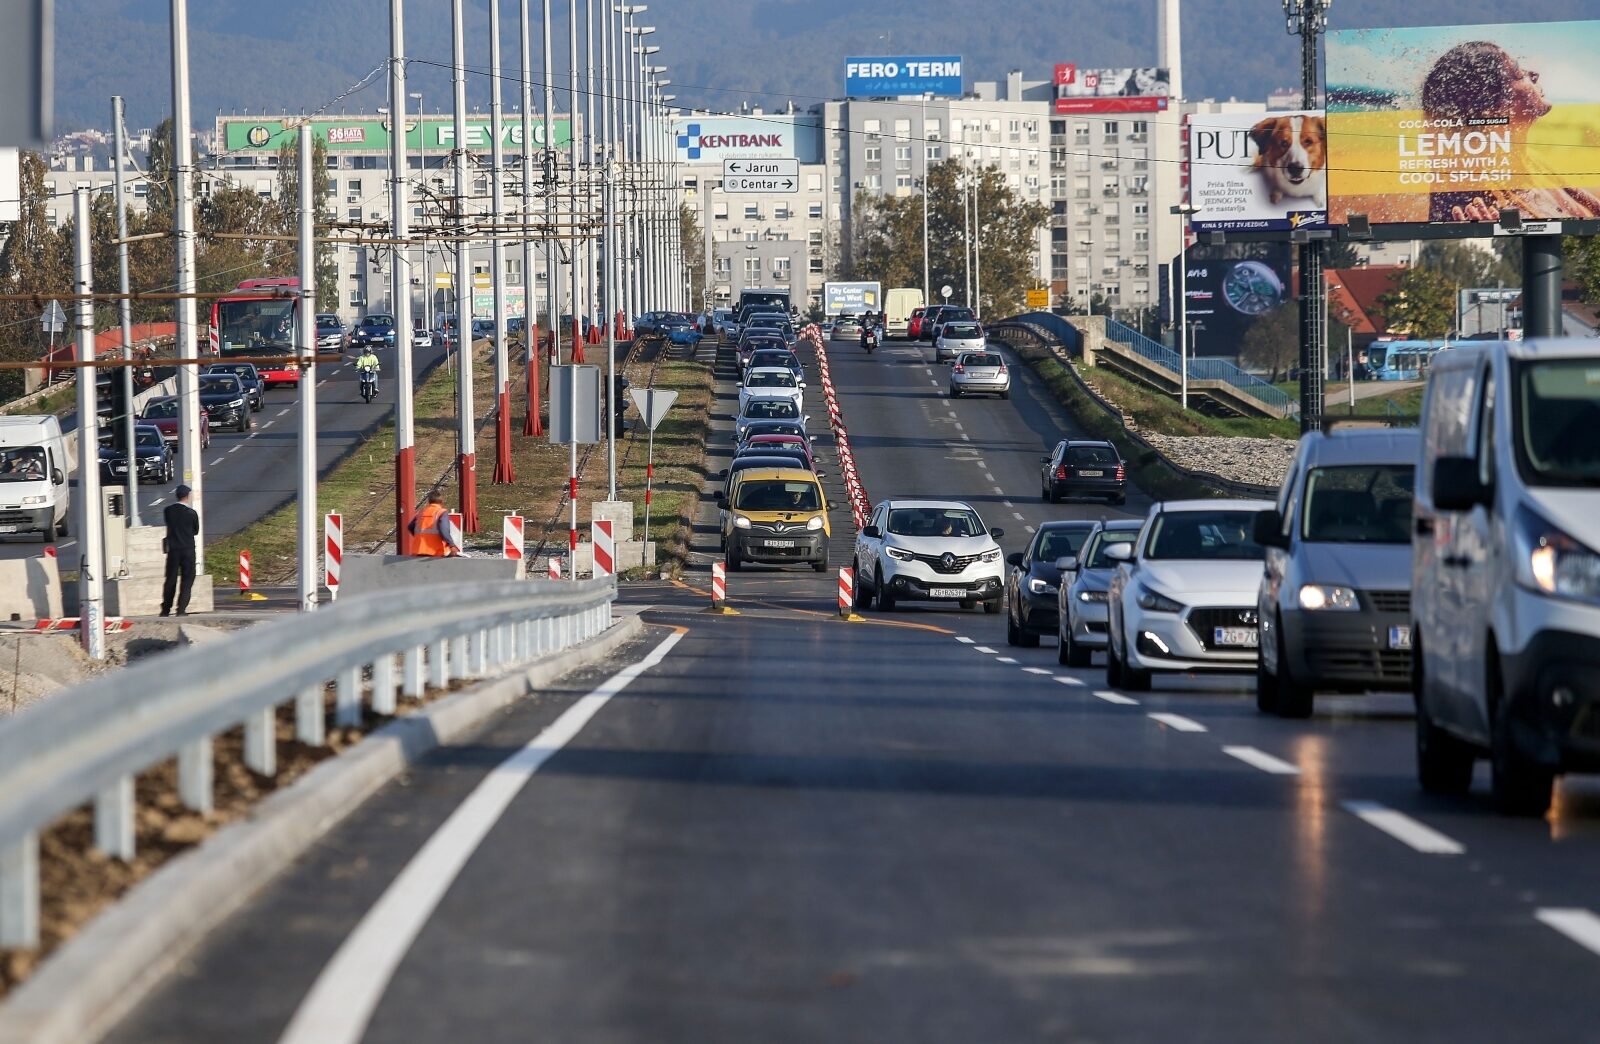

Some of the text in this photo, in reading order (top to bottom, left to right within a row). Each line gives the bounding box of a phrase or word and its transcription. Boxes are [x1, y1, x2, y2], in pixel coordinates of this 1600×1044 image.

[847, 61, 961, 78] FERO TERM
[1086, 77, 1097, 87] 10
[1399, 119, 1464, 129] COCA-COLA
[329, 128, 344, 139] 36
[699, 134, 783, 148] KENTBANK
[1196, 130, 1252, 160] PUT
[1398, 130, 1511, 157] LEMON
[746, 163, 779, 173] Jarun
[1399, 157, 1510, 170] REFRESH WITH A
[1399, 169, 1512, 184] COOL SPLASH
[741, 180, 778, 189] Centar
[1199, 189, 1226, 197] SMISAO
[1204, 197, 1233, 206] JEDNOG
[1186, 268, 1208, 278] AVI-8
[830, 286, 863, 295] City Center
[1223, 631, 1238, 644] ZG
